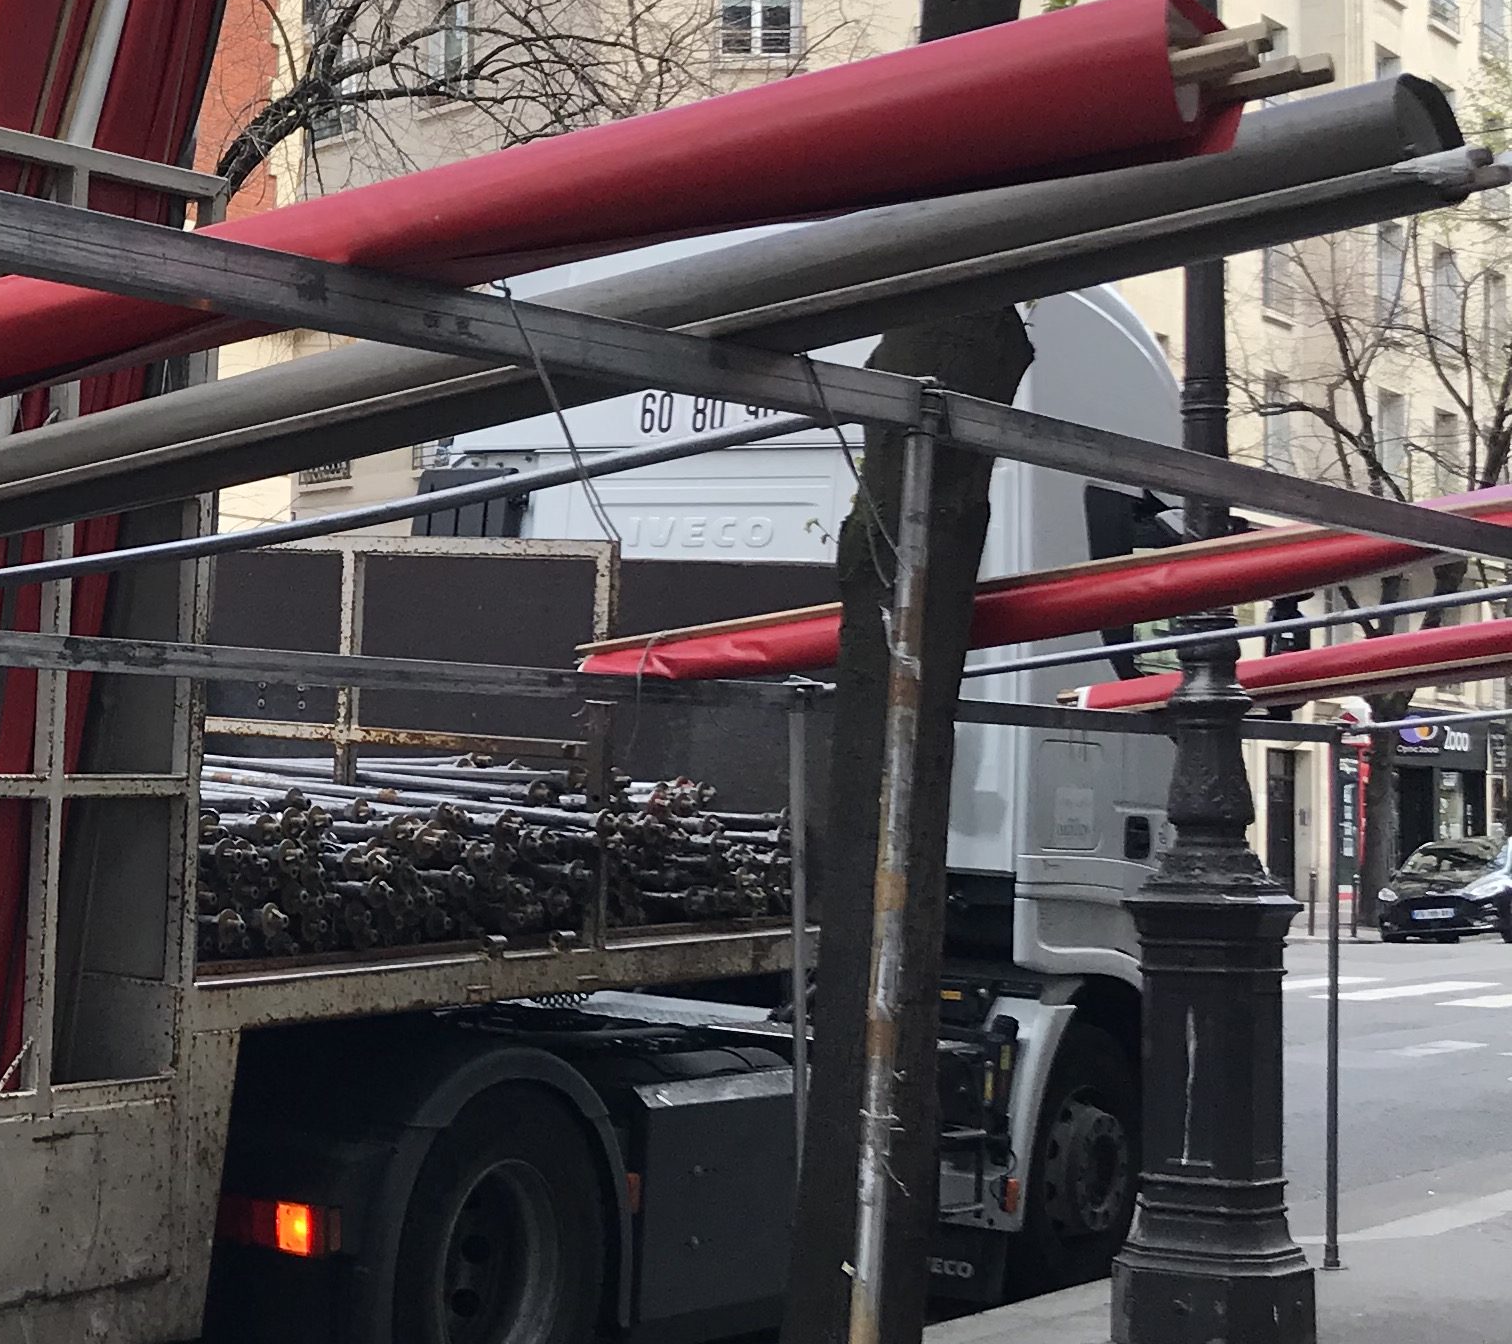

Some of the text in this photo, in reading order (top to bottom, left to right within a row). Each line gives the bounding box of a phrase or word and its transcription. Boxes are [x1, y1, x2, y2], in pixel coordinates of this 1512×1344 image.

[641, 392, 673, 433] 60
[693, 395, 725, 433] 80
[626, 515, 774, 549] IVECO
[926, 1256, 975, 1278] ECO
